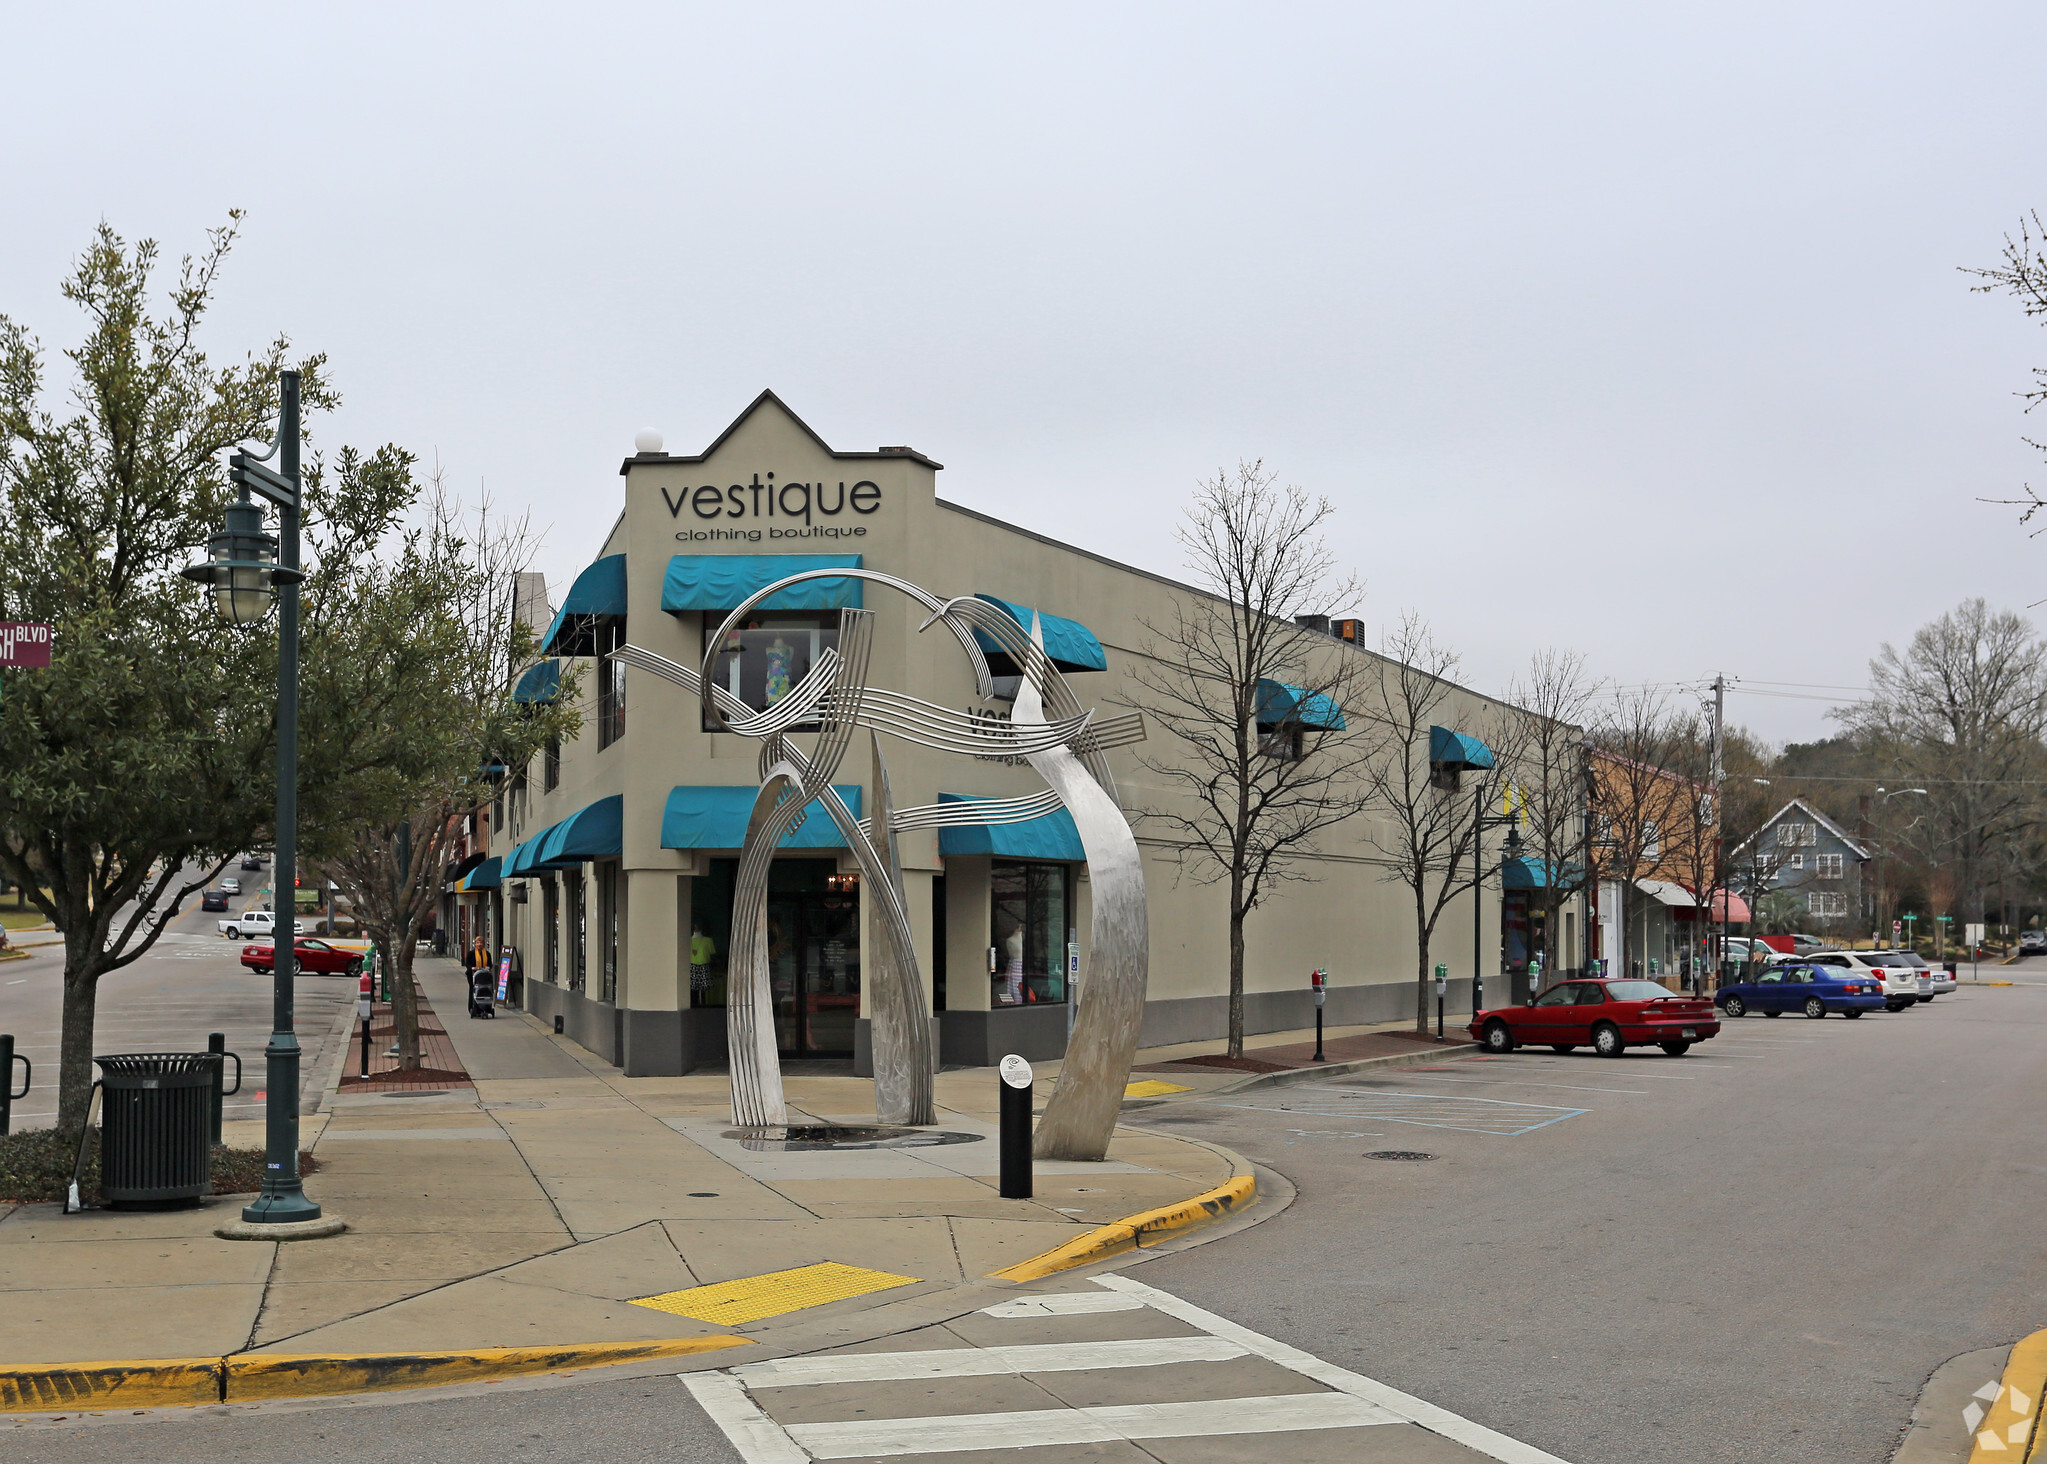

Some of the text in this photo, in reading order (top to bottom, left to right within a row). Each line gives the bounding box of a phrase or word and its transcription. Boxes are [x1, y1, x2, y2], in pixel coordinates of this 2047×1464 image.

[661, 471, 882, 526] vestique
[675, 525, 868, 542] clothing boutique
[16, 625, 48, 643] BLVD
